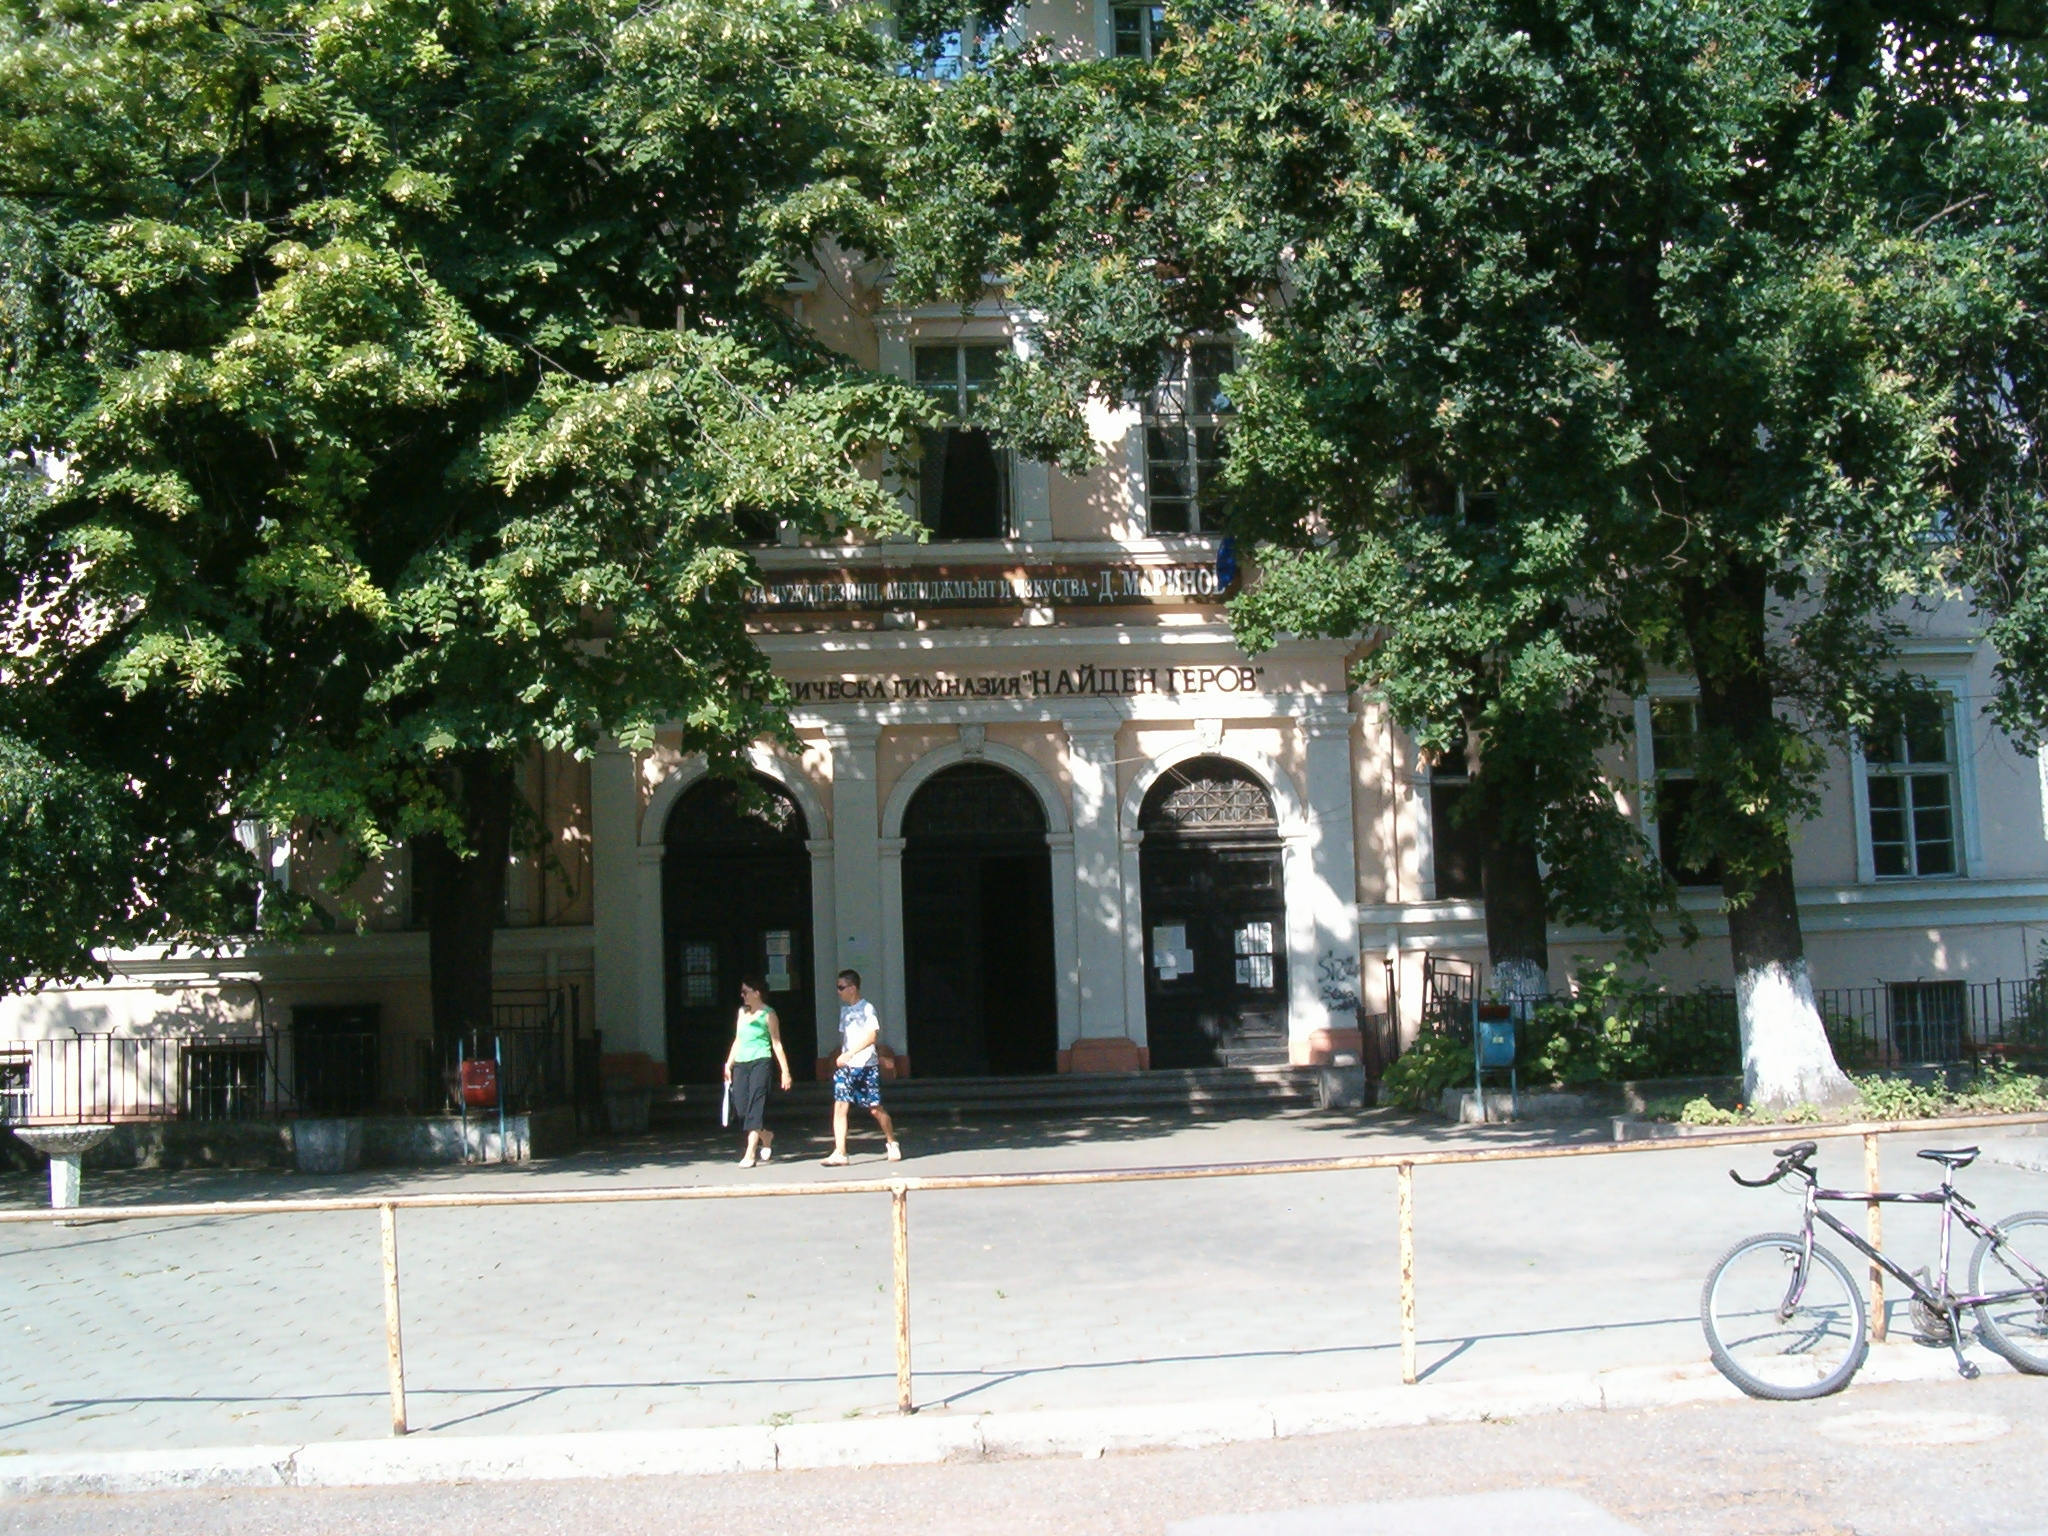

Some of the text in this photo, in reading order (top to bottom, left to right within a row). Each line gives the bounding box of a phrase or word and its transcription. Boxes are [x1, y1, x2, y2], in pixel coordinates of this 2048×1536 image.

[751, 585, 768, 604] ЗА
[886, 580, 997, 603] МЕНИДЖМЪНТ
[999, 579, 1012, 599] И
[1013, 577, 1089, 600] ИЗКУСТВА
[1098, 570, 1119, 602] Д.
[893, 675, 1021, 699] ГИМНАЗИЯ
